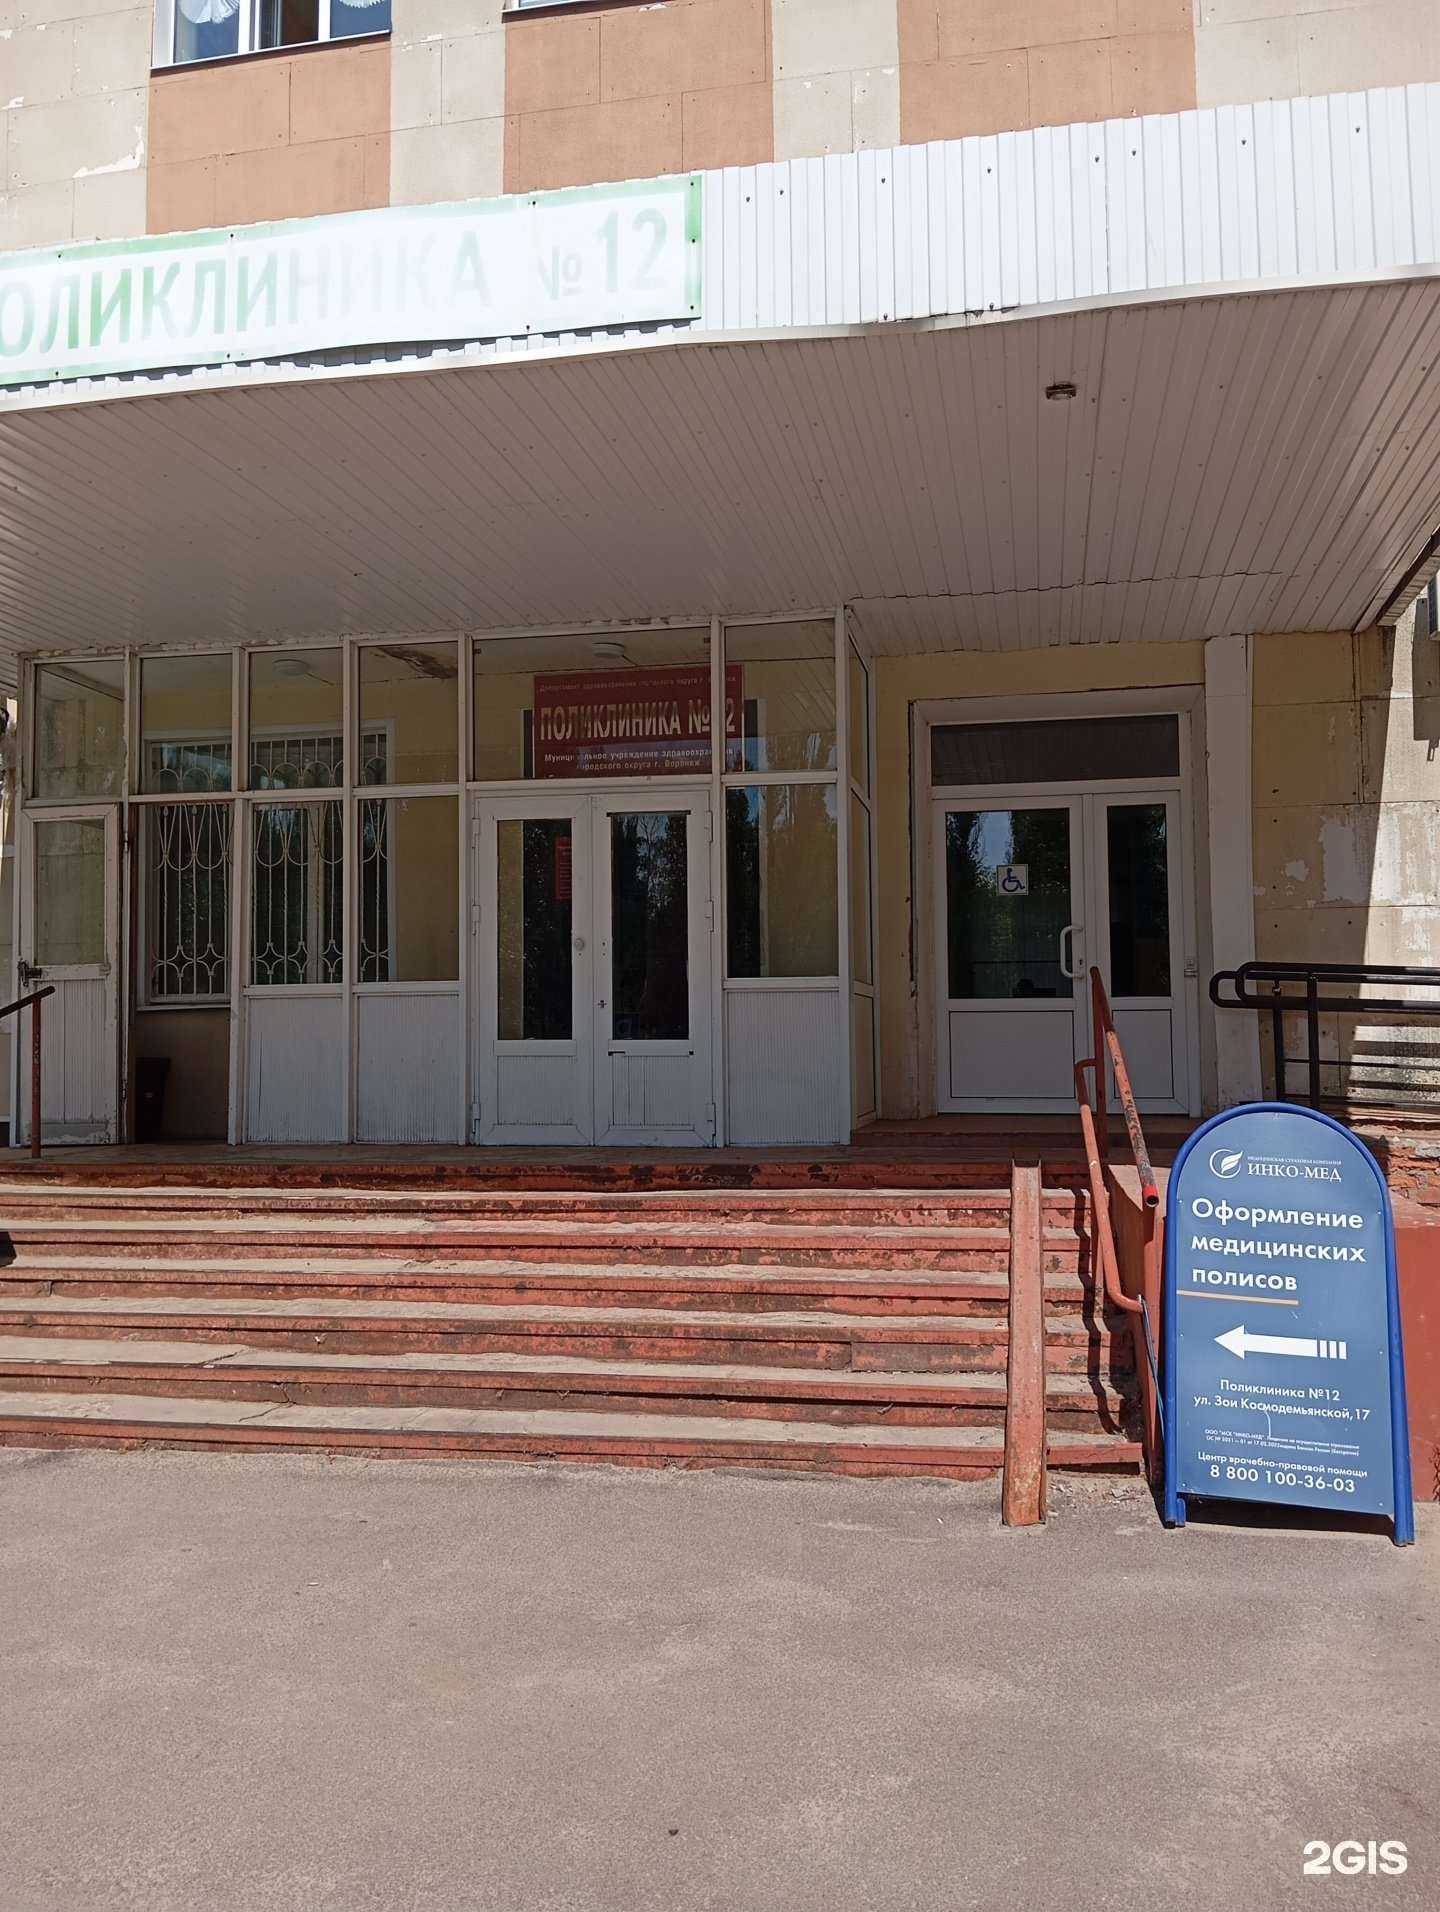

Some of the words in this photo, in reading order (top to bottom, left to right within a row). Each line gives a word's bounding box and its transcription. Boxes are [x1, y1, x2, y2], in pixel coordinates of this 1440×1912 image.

[594, 207, 669, 294] 12
[540, 700, 682, 742] ПОЛИКЛИНИКА
[1247, 1162, 1342, 1183] ИНКО-МЕД
[1192, 1198, 1364, 1229] Оформление
[1192, 1235, 1367, 1263] медицинских
[1192, 1268, 1298, 1291] полисов
[1193, 1396, 1211, 1407] ул.
[1215, 1396, 1238, 1409] Зои
[1220, 1379, 1305, 1399] Поликлиника
[1198, 1451, 1227, 1464] Центр
[1229, 1455, 1326, 1474] врачебно-правовой
[1327, 1467, 1368, 1479] помощи
[1209, 1465, 1220, 1478] 8
[1226, 1466, 1259, 1482] 800
[1265, 1470, 1356, 1493] 100-36-03
